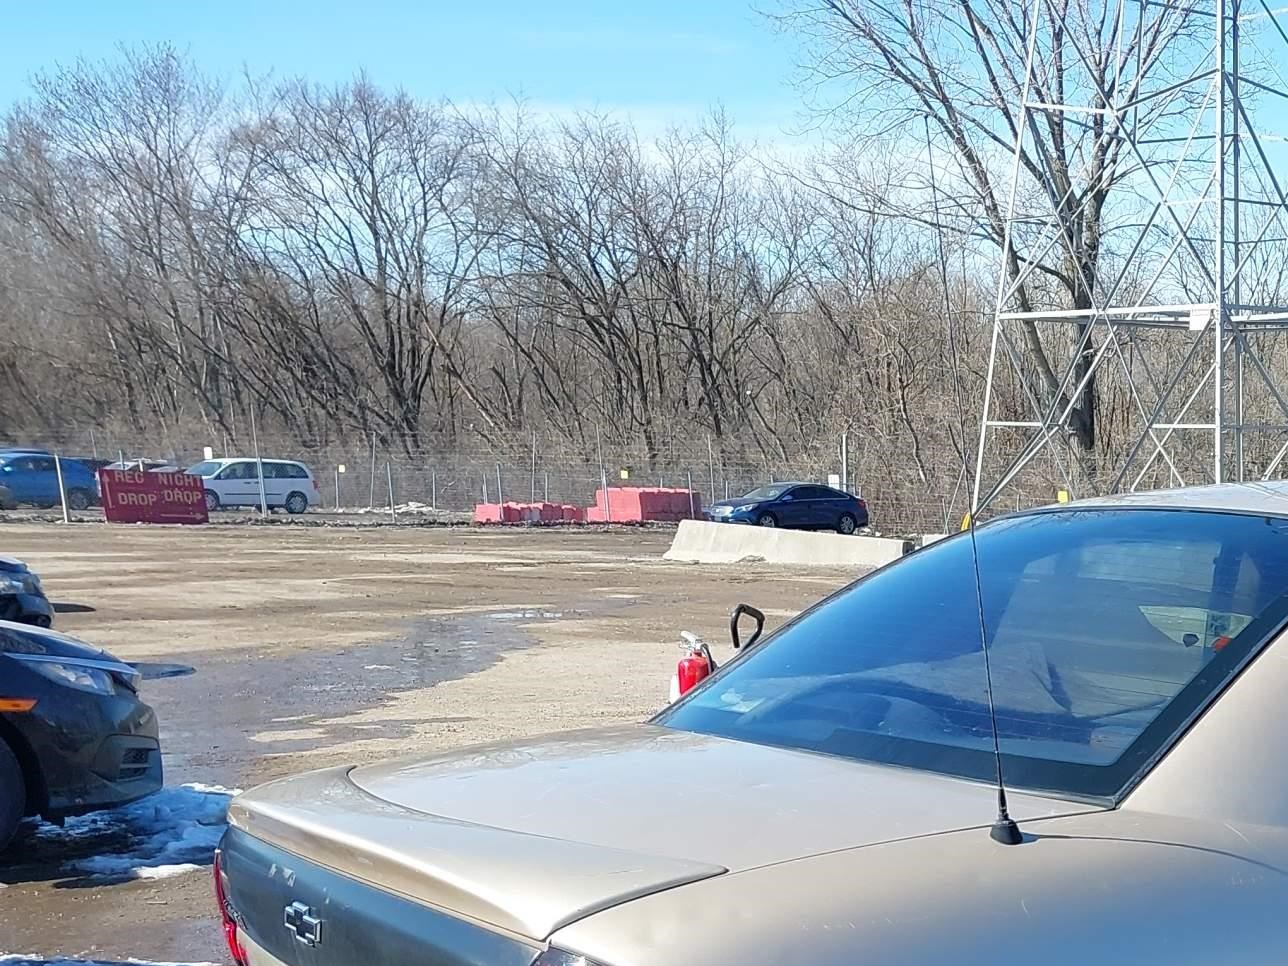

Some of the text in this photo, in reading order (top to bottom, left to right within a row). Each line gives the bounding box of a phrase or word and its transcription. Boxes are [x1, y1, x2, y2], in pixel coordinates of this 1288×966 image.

[159, 474, 202, 487] NIGHT
[118, 492, 157, 506] DROP
[164, 490, 202, 503] DROP
